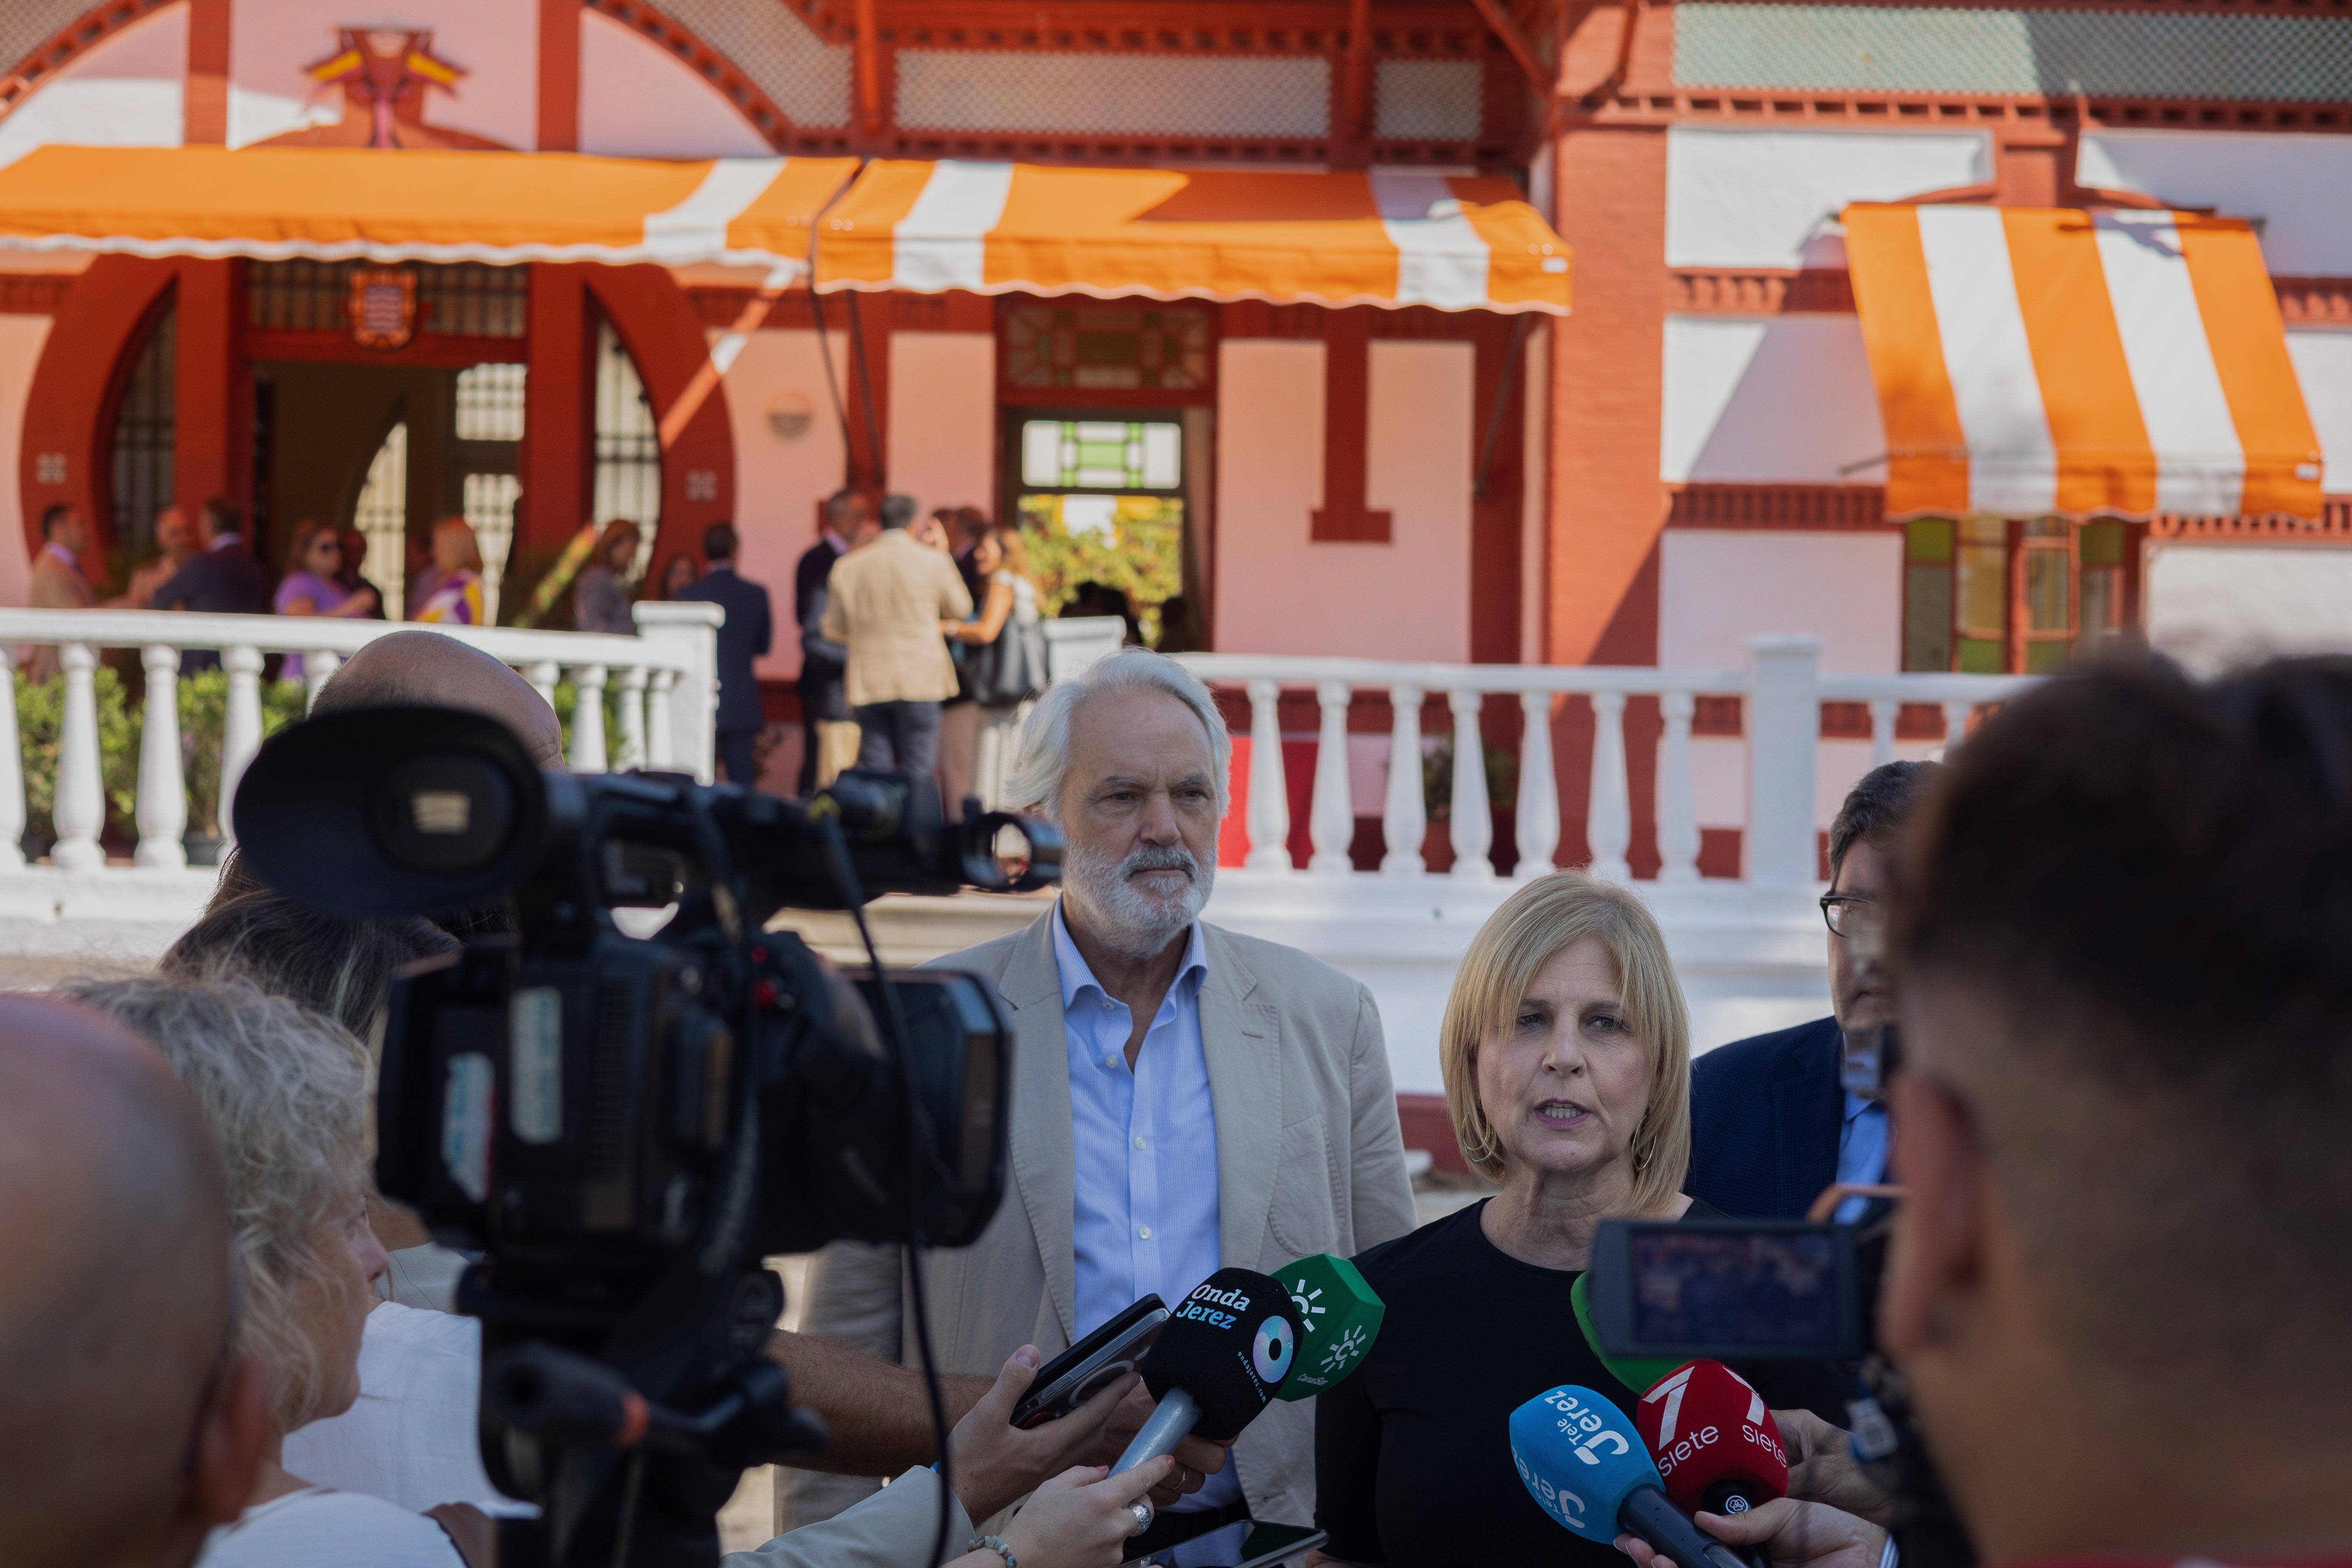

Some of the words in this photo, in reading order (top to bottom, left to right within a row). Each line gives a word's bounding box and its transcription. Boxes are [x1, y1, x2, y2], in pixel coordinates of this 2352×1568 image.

[1192, 1284, 1250, 1311] Onda
[1176, 1301, 1237, 1329] Jerez
[1238, 1351, 1266, 1403] ondajerez.com
[1544, 1390, 1629, 1465] Jerez
[1557, 1418, 1583, 1446] Tele
